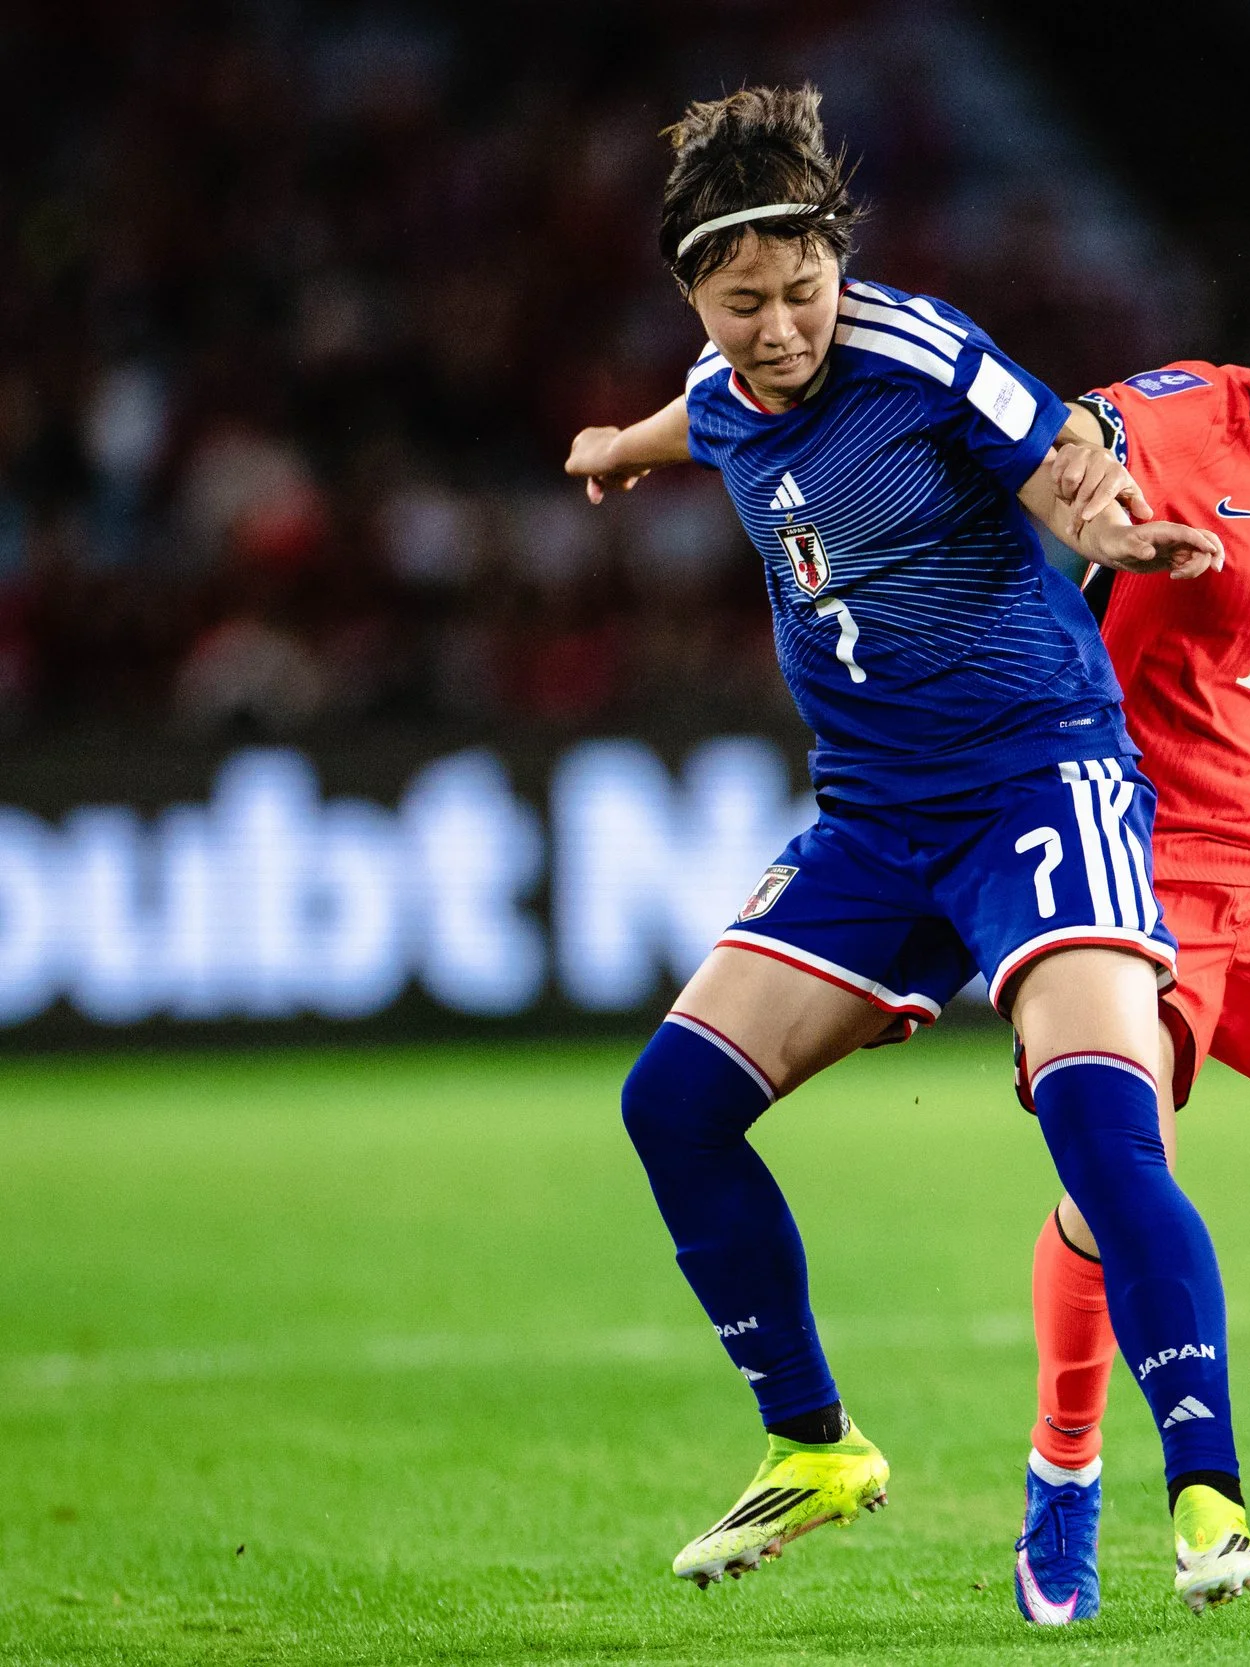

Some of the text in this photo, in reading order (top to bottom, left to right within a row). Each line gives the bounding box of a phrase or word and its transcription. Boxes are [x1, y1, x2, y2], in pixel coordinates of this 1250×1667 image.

[786, 526, 807, 536] JAPAN
[815, 597, 867, 683] 7
[1015, 826, 1064, 919] 7
[1138, 1344, 1216, 1380] JAPAN
